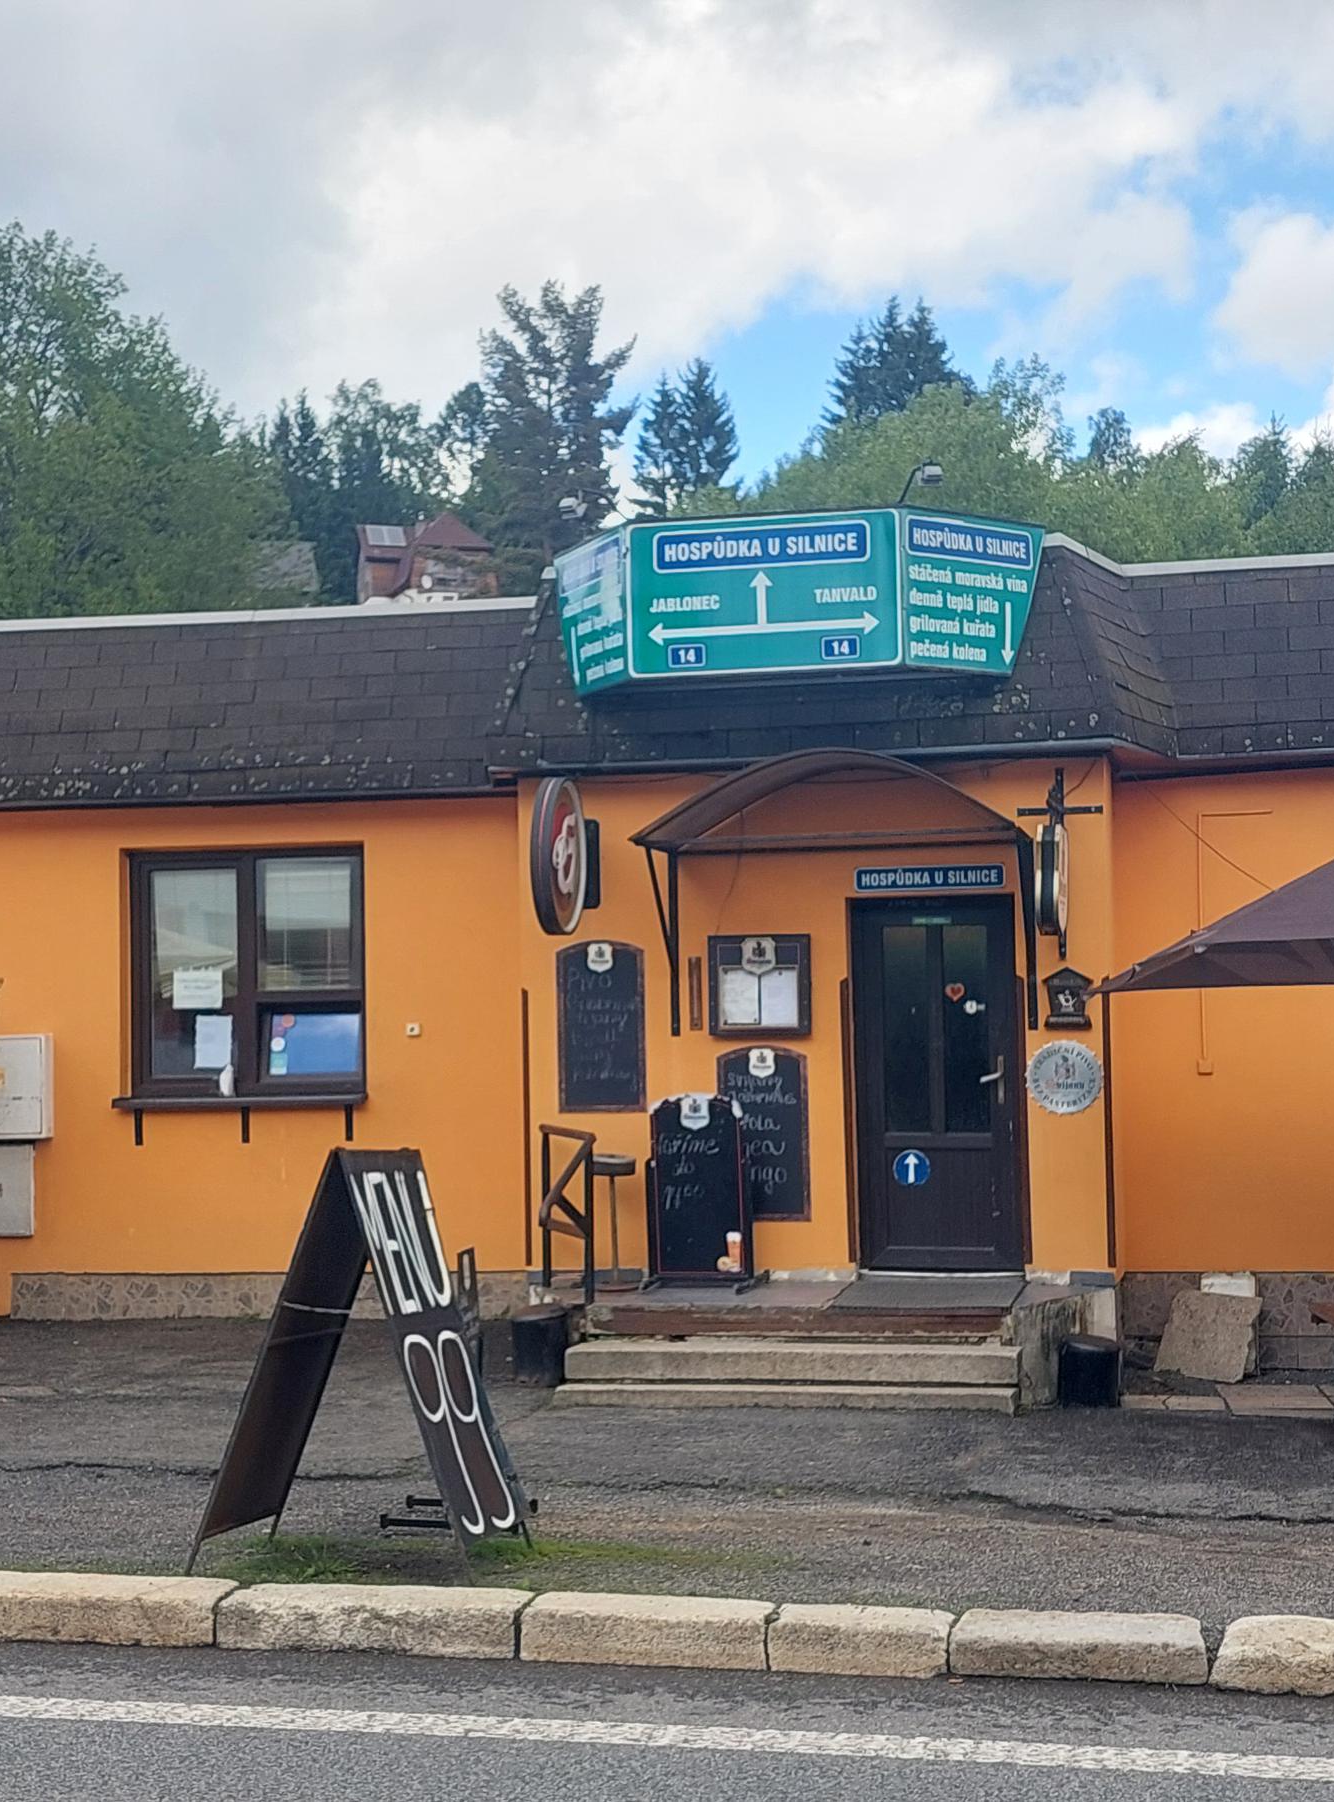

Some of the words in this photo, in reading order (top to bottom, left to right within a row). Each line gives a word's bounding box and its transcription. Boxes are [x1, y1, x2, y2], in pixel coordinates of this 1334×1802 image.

[663, 536, 763, 563] HOSPŮDKA
[767, 537, 780, 556] U
[785, 532, 858, 554] SILNICE
[912, 527, 974, 552] HOSPŮDKA
[975, 535, 984, 553] U
[985, 537, 1027, 560] SILNICE
[908, 563, 953, 584] stáčená
[955, 571, 1004, 591] moravská
[649, 594, 721, 614] JABLONEC
[813, 586, 878, 604] TANVALD
[909, 587, 943, 608] denně
[946, 592, 974, 613] teplá
[909, 614, 960, 635] grilovaná
[962, 618, 996, 638] kuřata
[677, 647, 696, 664] 14
[831, 639, 850, 656] 14
[910, 639, 950, 659] pečená
[952, 642, 987, 662] kolena
[860, 868, 931, 887] HOSPŮDKA
[934, 870, 944, 885] U
[947, 869, 999, 885] SILNICE
[349, 1169, 454, 1317] MENU
